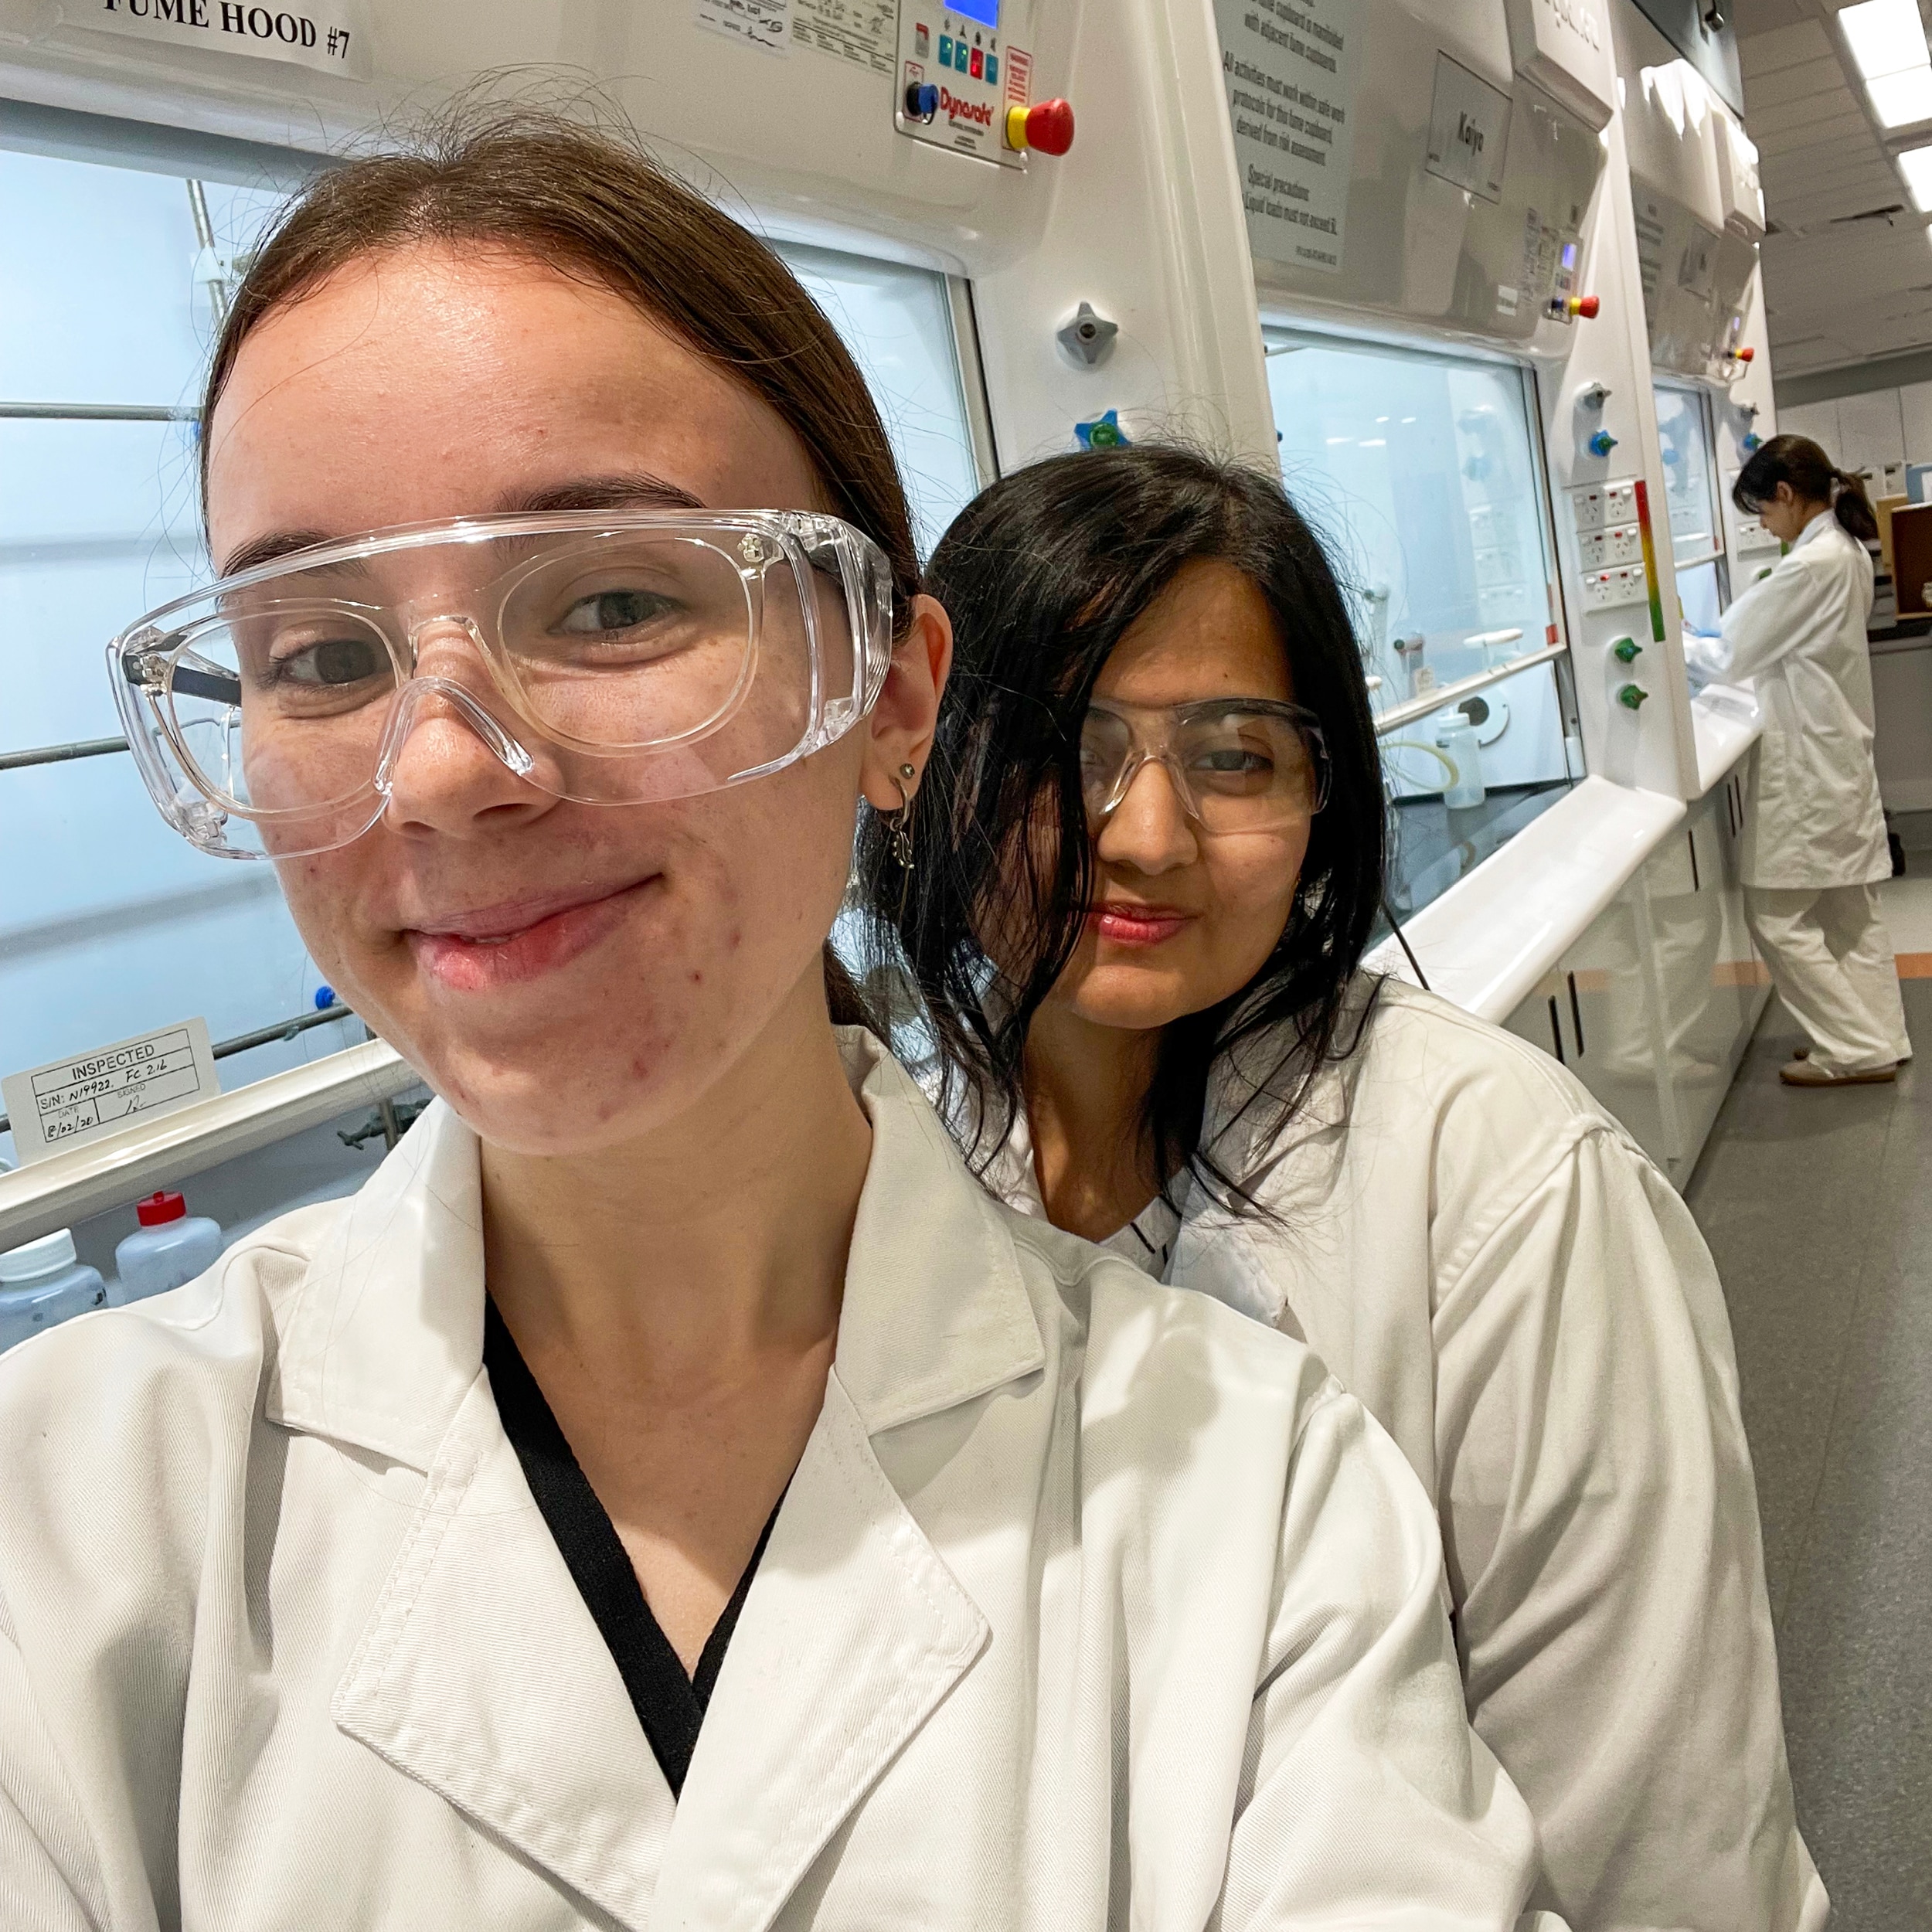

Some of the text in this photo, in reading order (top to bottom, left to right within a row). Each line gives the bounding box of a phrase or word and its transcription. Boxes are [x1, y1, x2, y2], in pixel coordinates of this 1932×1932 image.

[218, 1, 317, 47] HOOD
[328, 26, 350, 59] #7
[72, 1044, 155, 1080] INSPECTED
[117, 1083, 146, 1098] SIGNED
[40, 1095, 65, 1110] S/N:
[58, 1106, 80, 1119] DATE
